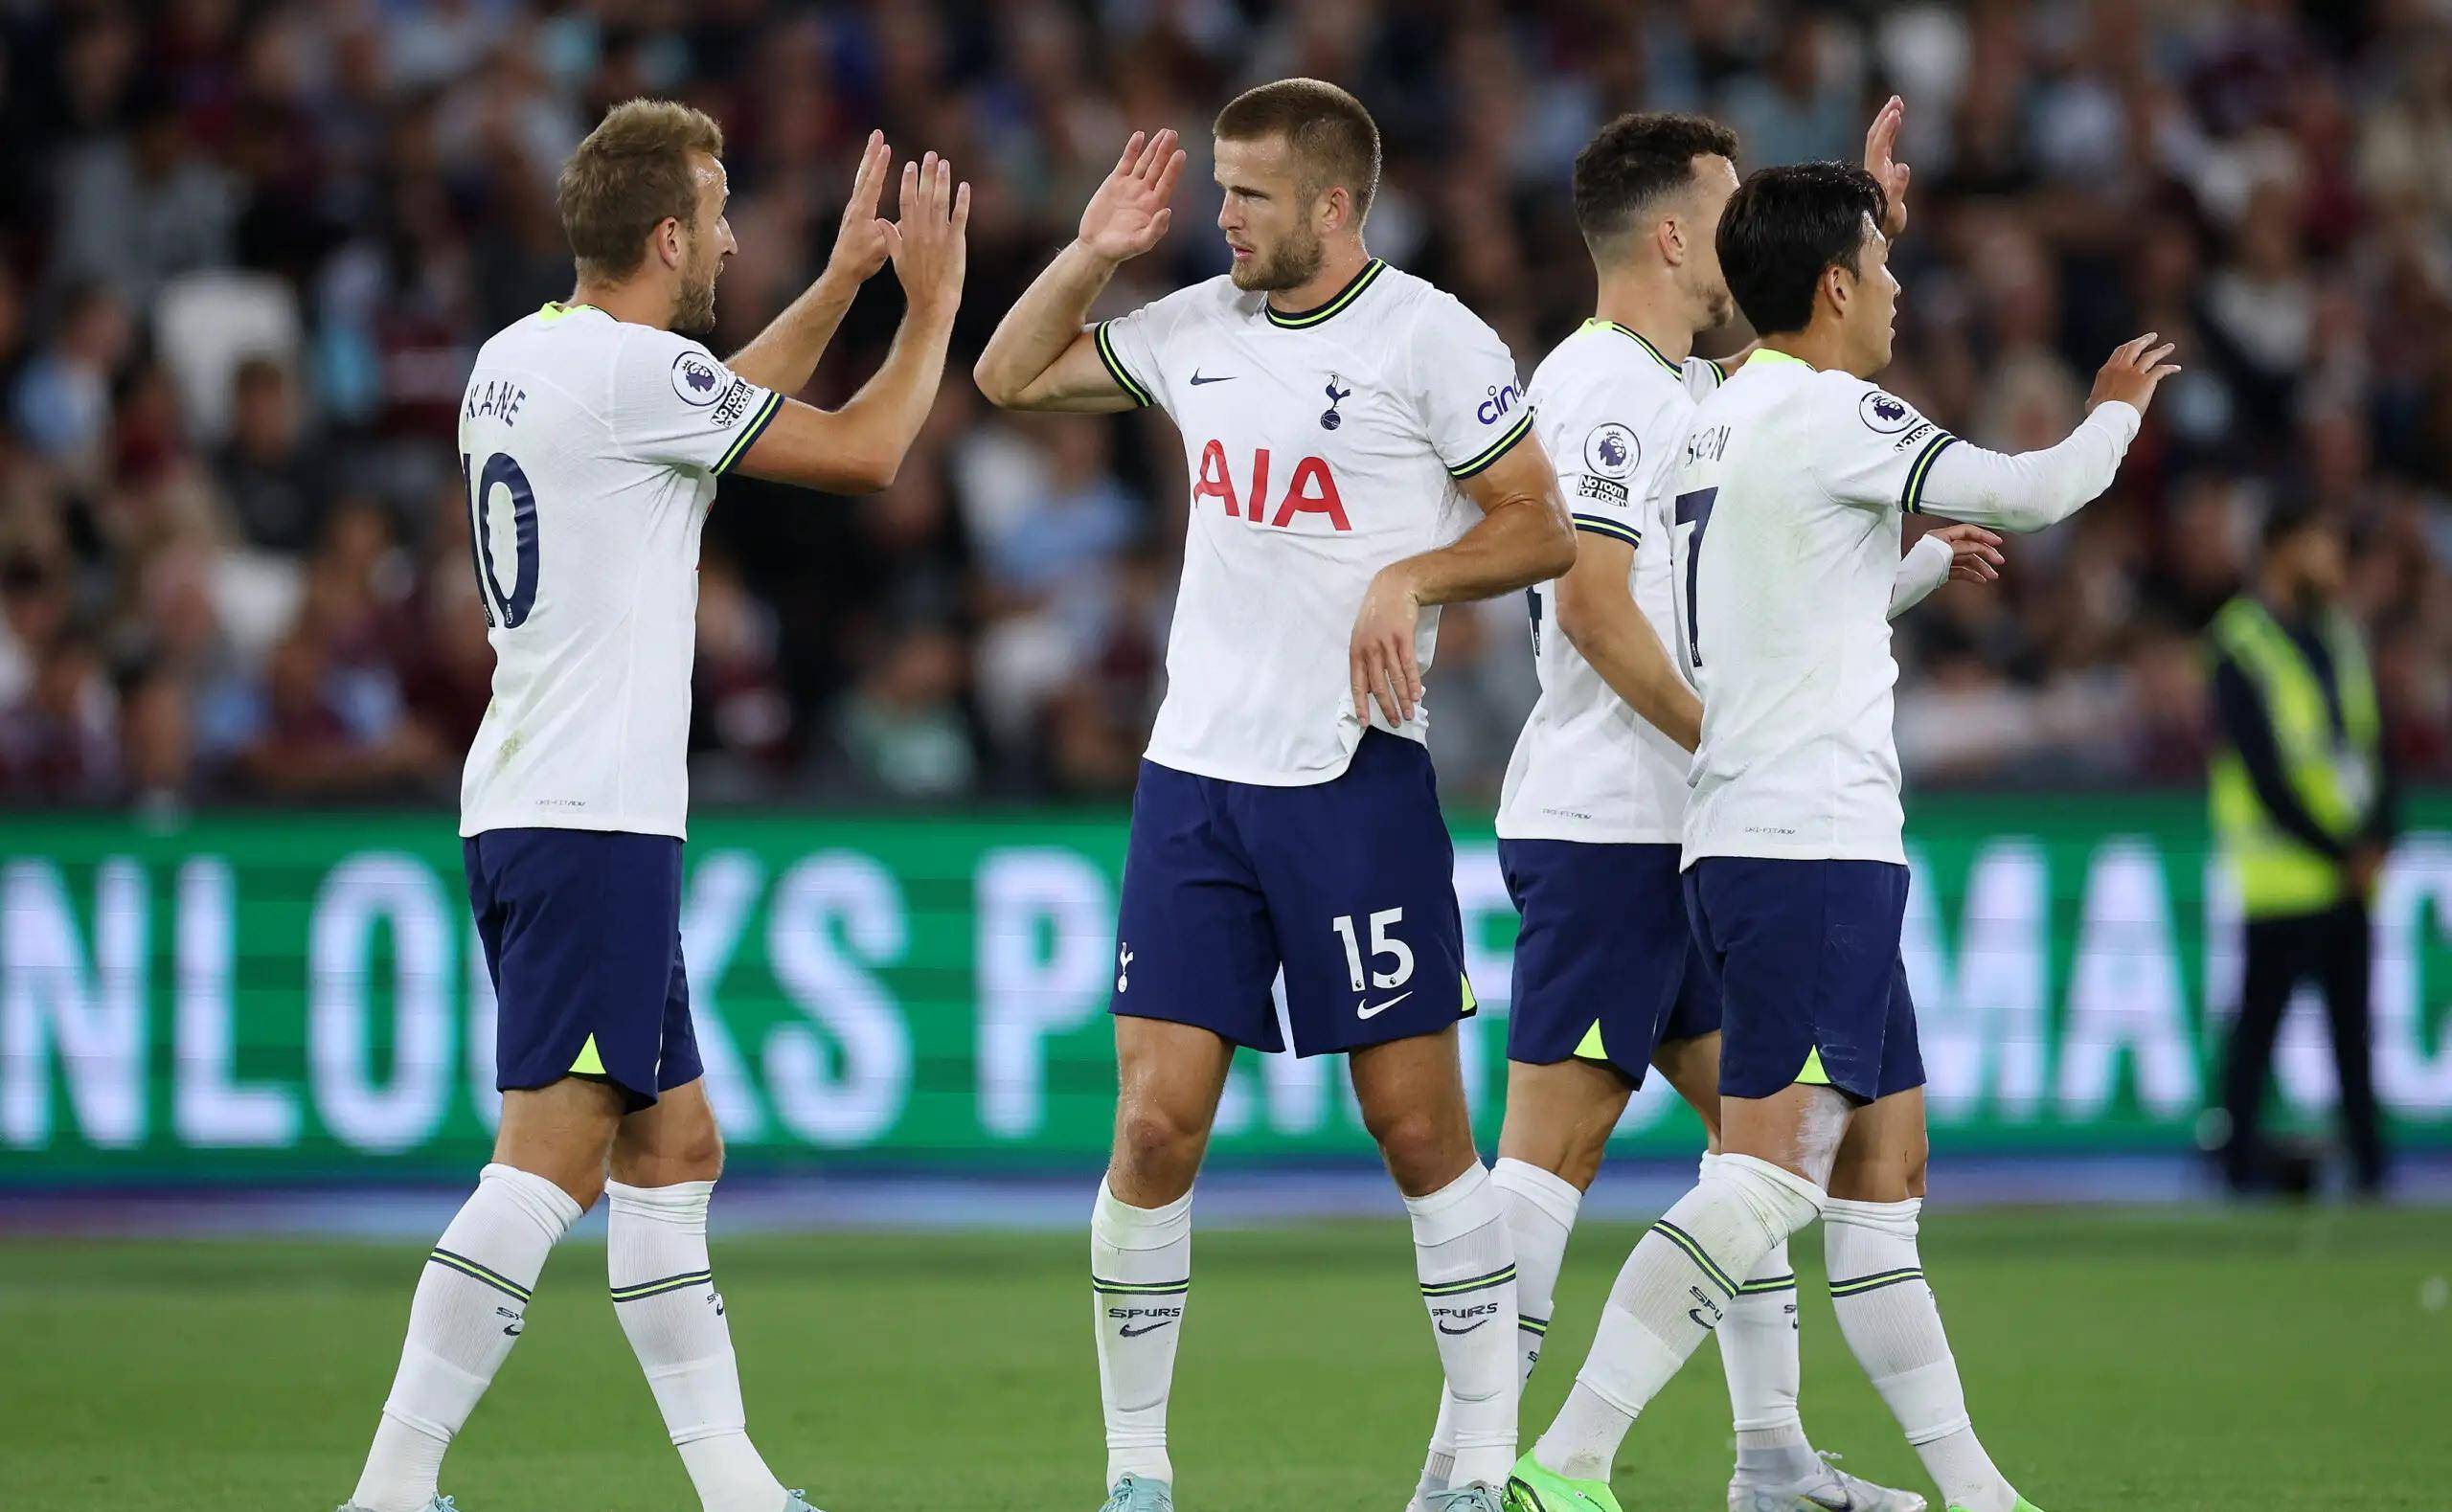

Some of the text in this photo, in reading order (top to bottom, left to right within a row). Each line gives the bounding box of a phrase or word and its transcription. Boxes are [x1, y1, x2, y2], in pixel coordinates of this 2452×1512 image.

[465, 380, 527, 428] KANE
[1685, 425, 1731, 466] SON
[1193, 440, 1352, 531] AIA
[1675, 486, 1719, 668] 7
[1332, 906, 1415, 992] 15
[0, 850, 914, 1147] NLOKS
[1108, 1307, 1182, 1319] SPURS
[1431, 1302, 1498, 1319] SPURS
